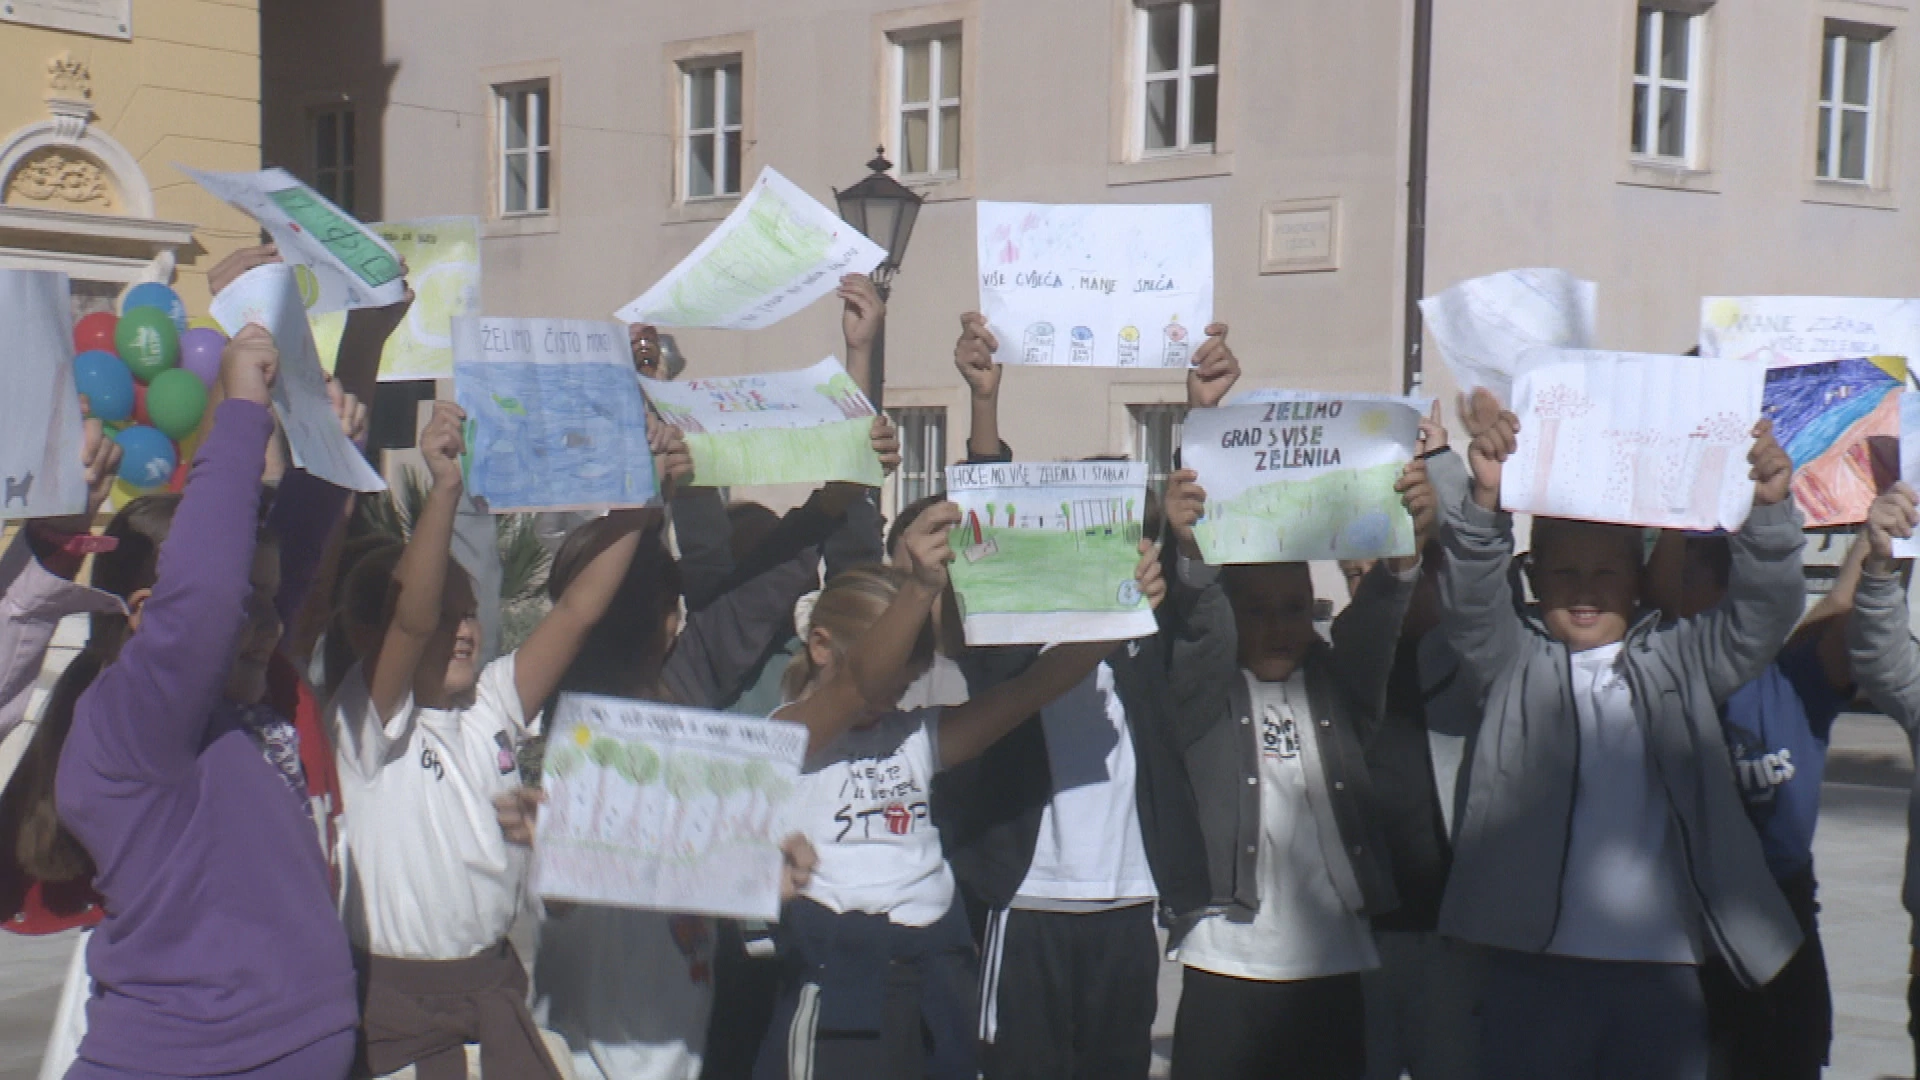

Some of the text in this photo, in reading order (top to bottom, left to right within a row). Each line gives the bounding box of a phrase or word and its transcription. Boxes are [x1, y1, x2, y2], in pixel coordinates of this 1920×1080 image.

[1079, 275, 1117, 294] MANJE
[544, 327, 581, 354] ČISTO
[1221, 427, 1262, 448] GRAD
[1267, 427, 1278, 447] S
[1255, 447, 1341, 471] ZELENILA
